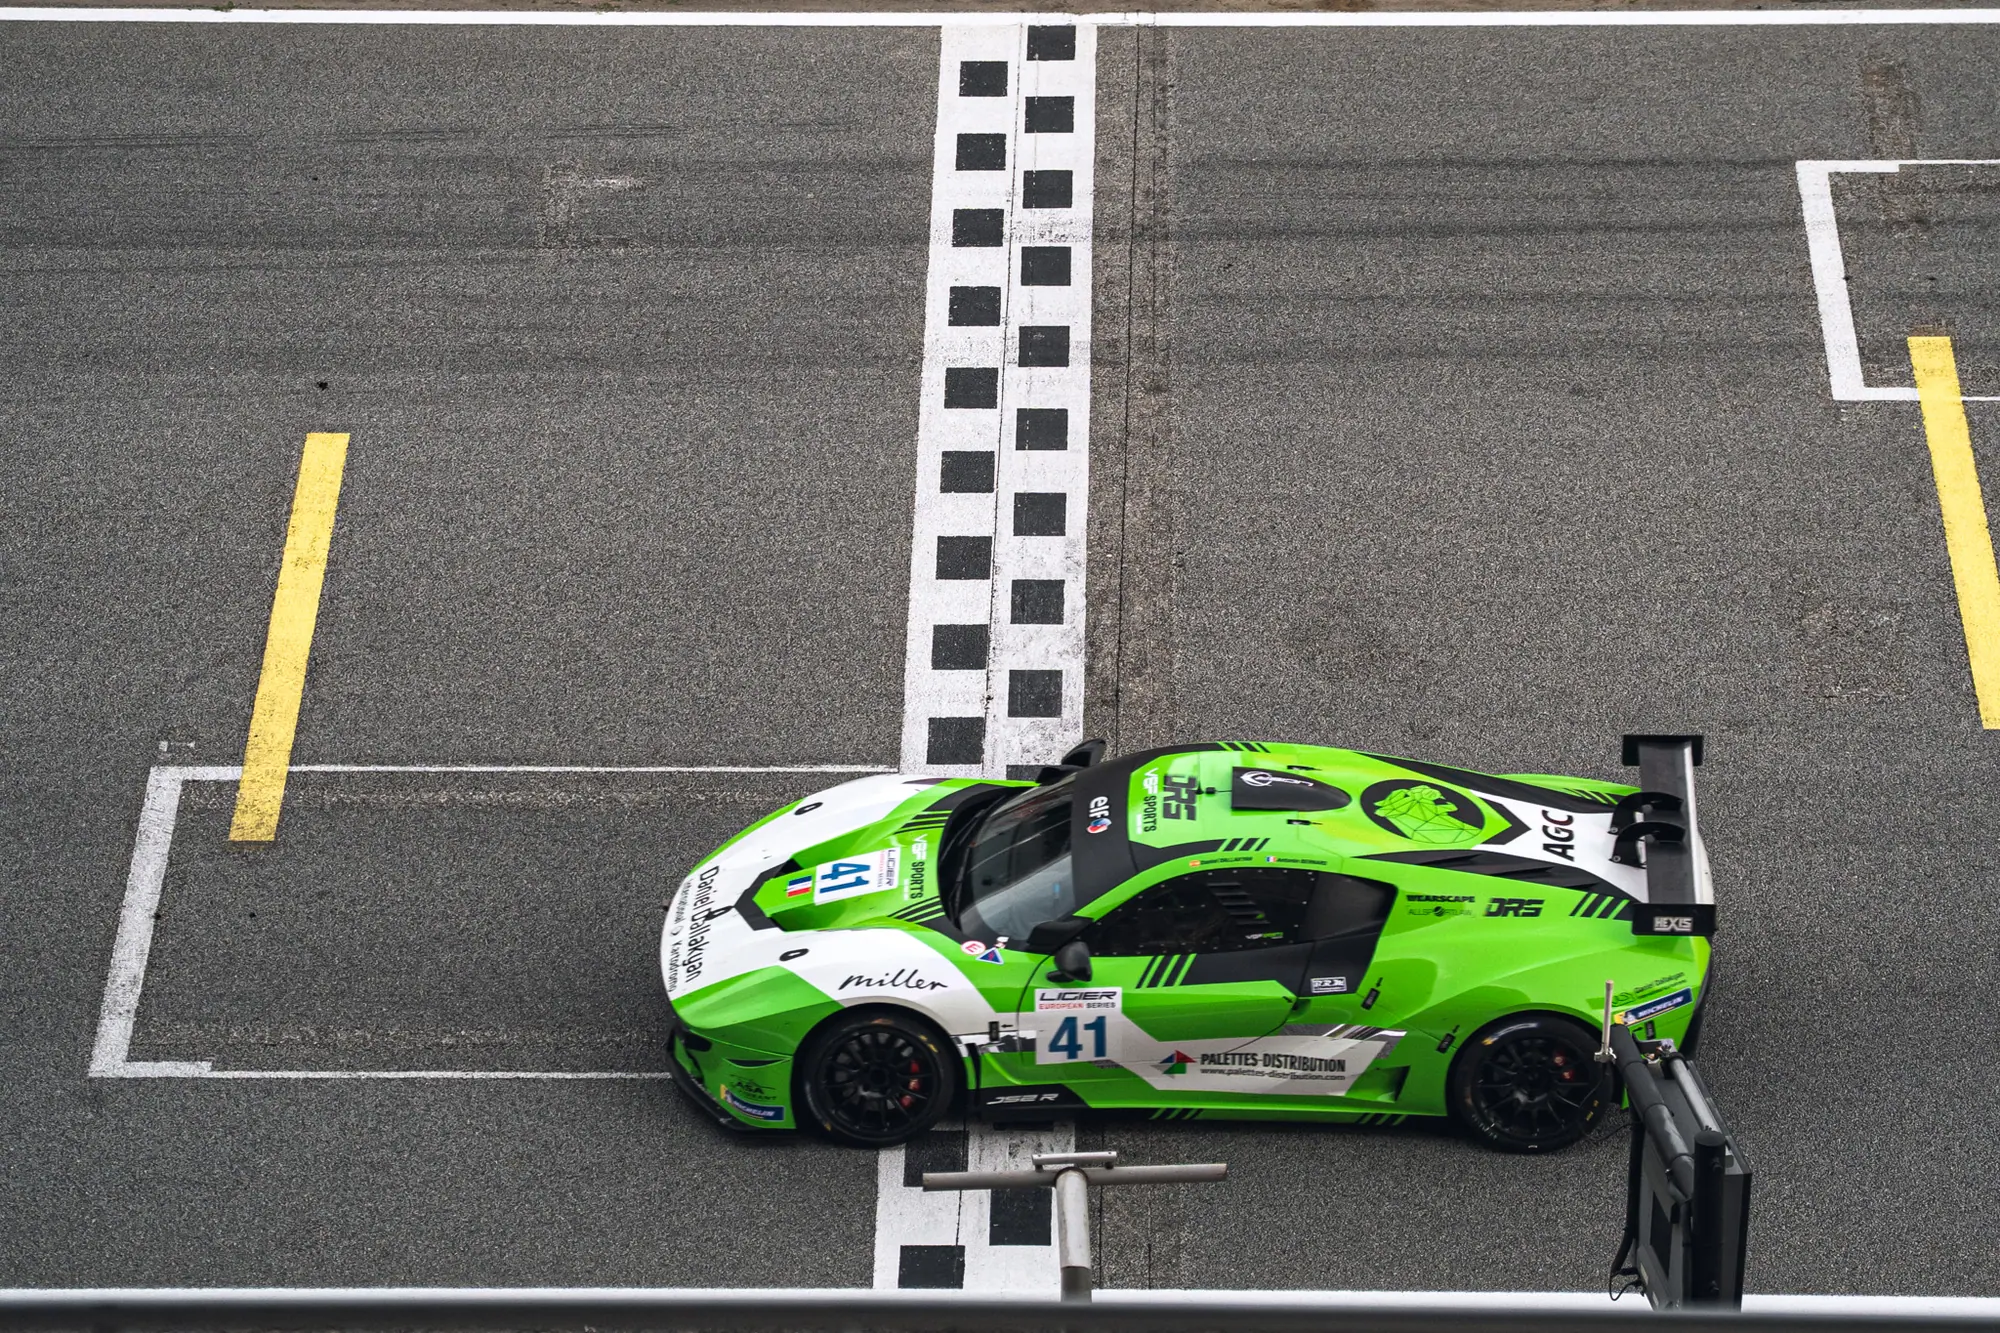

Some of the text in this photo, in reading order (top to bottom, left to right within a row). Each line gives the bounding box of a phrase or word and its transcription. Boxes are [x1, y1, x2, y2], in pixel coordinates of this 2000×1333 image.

[1088, 795, 1109, 818] elf
[1163, 774, 1197, 821] DRS
[1143, 795, 1157, 832] SPORTS
[1541, 809, 1575, 862] AGC
[819, 862, 871, 894] 41
[910, 861, 925, 900] SPORTS
[1406, 895, 1476, 903] WEARSCAPE
[1484, 897, 1545, 917] DRS
[682, 865, 720, 983] Daniel Dallakyan
[1654, 917, 1693, 931] HEXIS
[838, 969, 948, 990] miller
[1038, 1001, 1116, 1010] EUROPEAN SERIES
[1039, 991, 1118, 1001] LIGIER
[1048, 1015, 1107, 1059] 41
[1200, 1052, 1346, 1073] PALETTES-DISTRIBUTION
[1200, 1067, 1346, 1081] www.palettes-distribution.com
[1040, 1093, 1060, 1101] R
